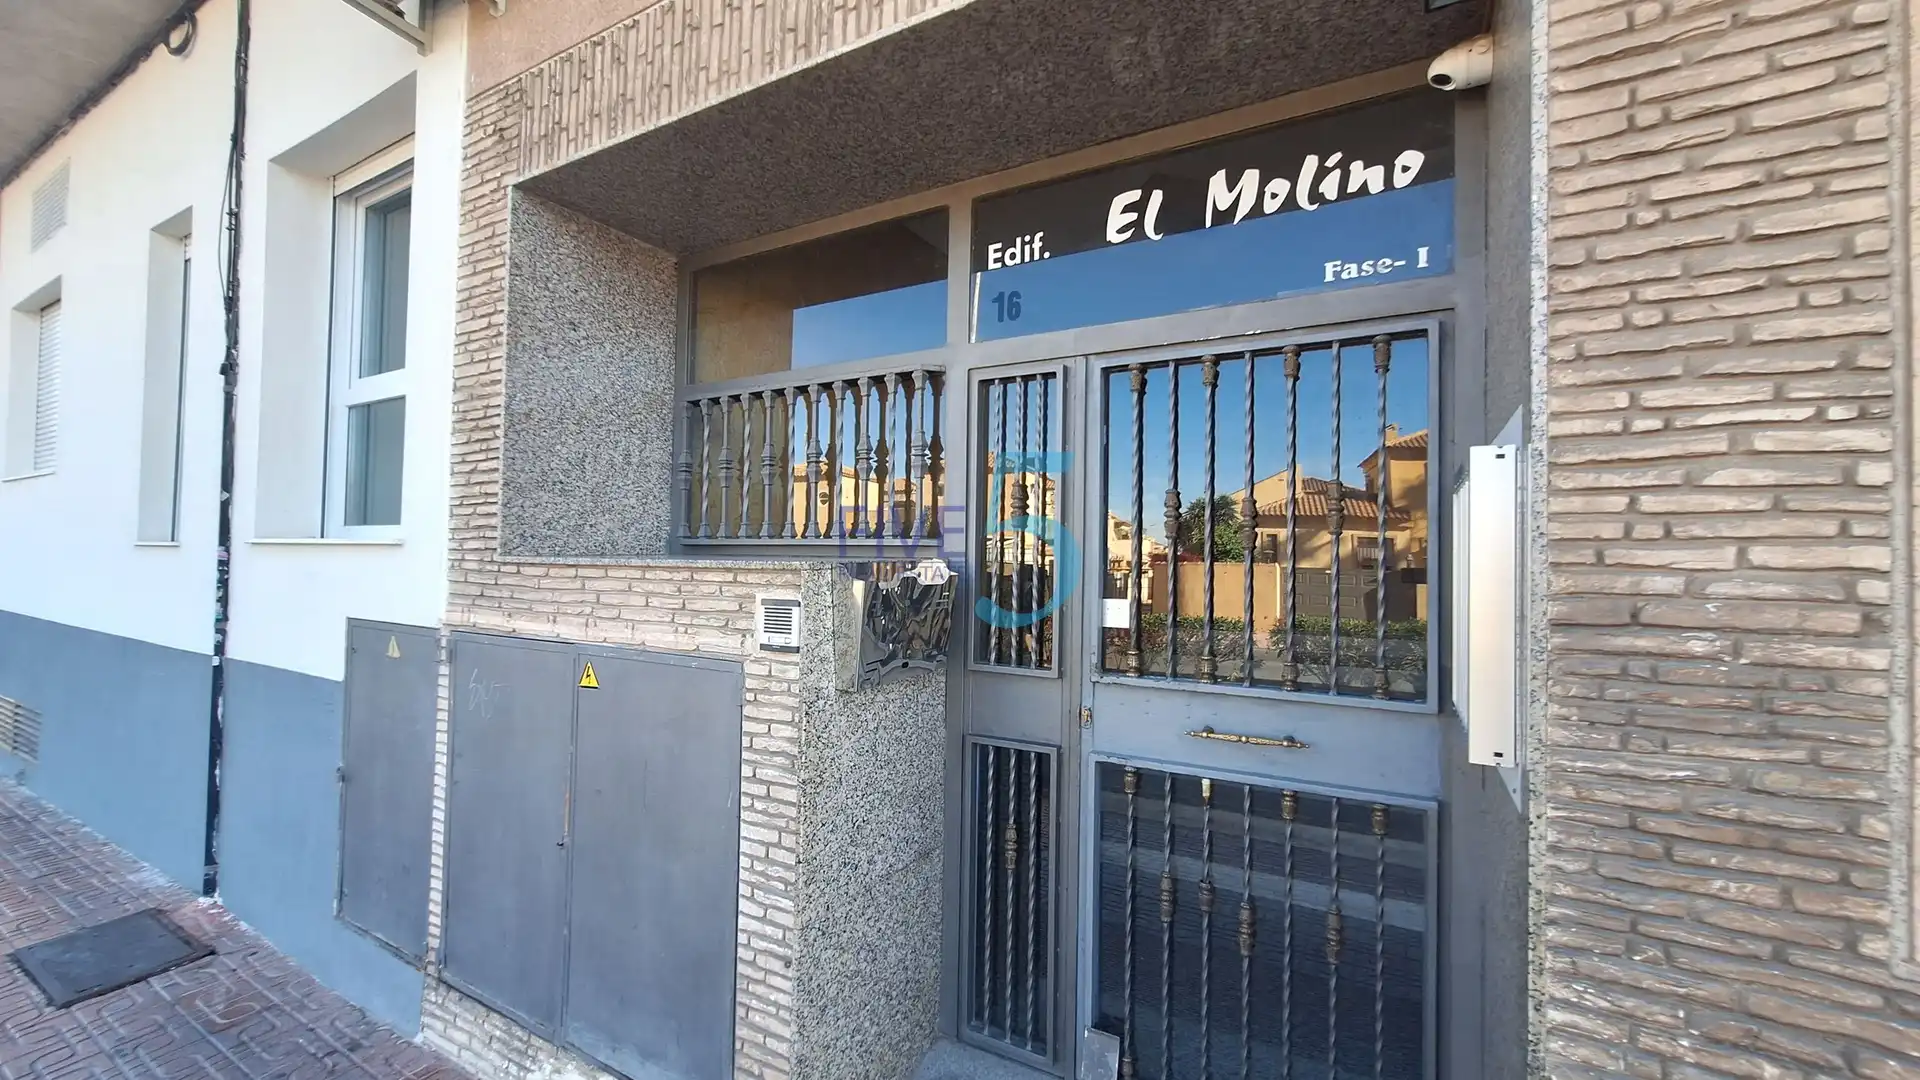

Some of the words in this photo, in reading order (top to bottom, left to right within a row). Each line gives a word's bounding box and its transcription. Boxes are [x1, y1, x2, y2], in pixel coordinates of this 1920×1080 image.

[986, 231, 1051, 270] Edif.
[1105, 188, 1164, 244] El
[1416, 246, 1429, 269] I
[992, 290, 1022, 322] 16
